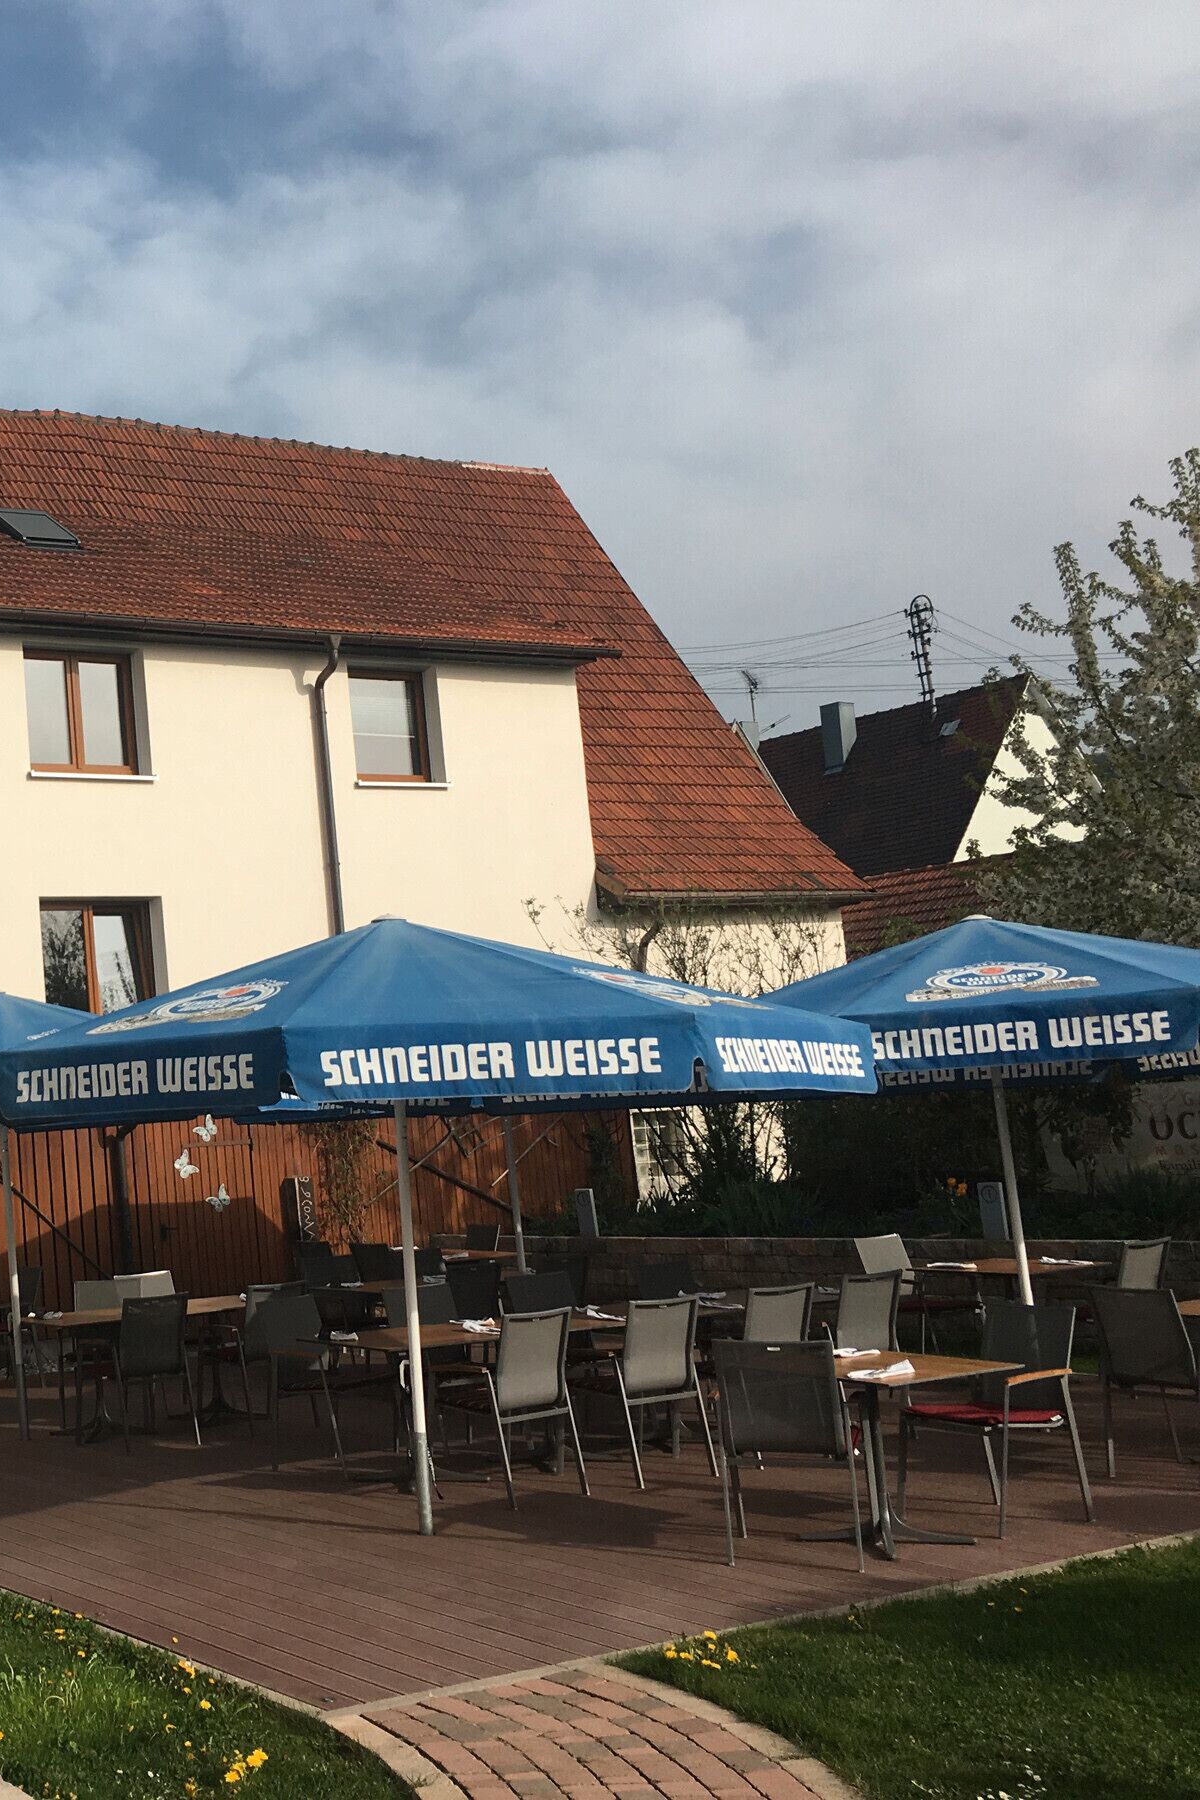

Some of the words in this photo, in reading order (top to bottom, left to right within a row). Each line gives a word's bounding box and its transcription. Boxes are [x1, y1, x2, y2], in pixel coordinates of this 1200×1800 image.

[715, 1037, 808, 1073] SCHNEIDER
[802, 1040, 866, 1078] WEISSE
[871, 1020, 1039, 1060] SCHNEIDER
[1048, 1010, 1171, 1048] WEISSE
[16, 1060, 149, 1103] SCHNEIDER
[156, 1053, 254, 1094] WEISSE
[320, 1042, 515, 1087] SCHNEIDER
[525, 1037, 662, 1078] WEISSE
